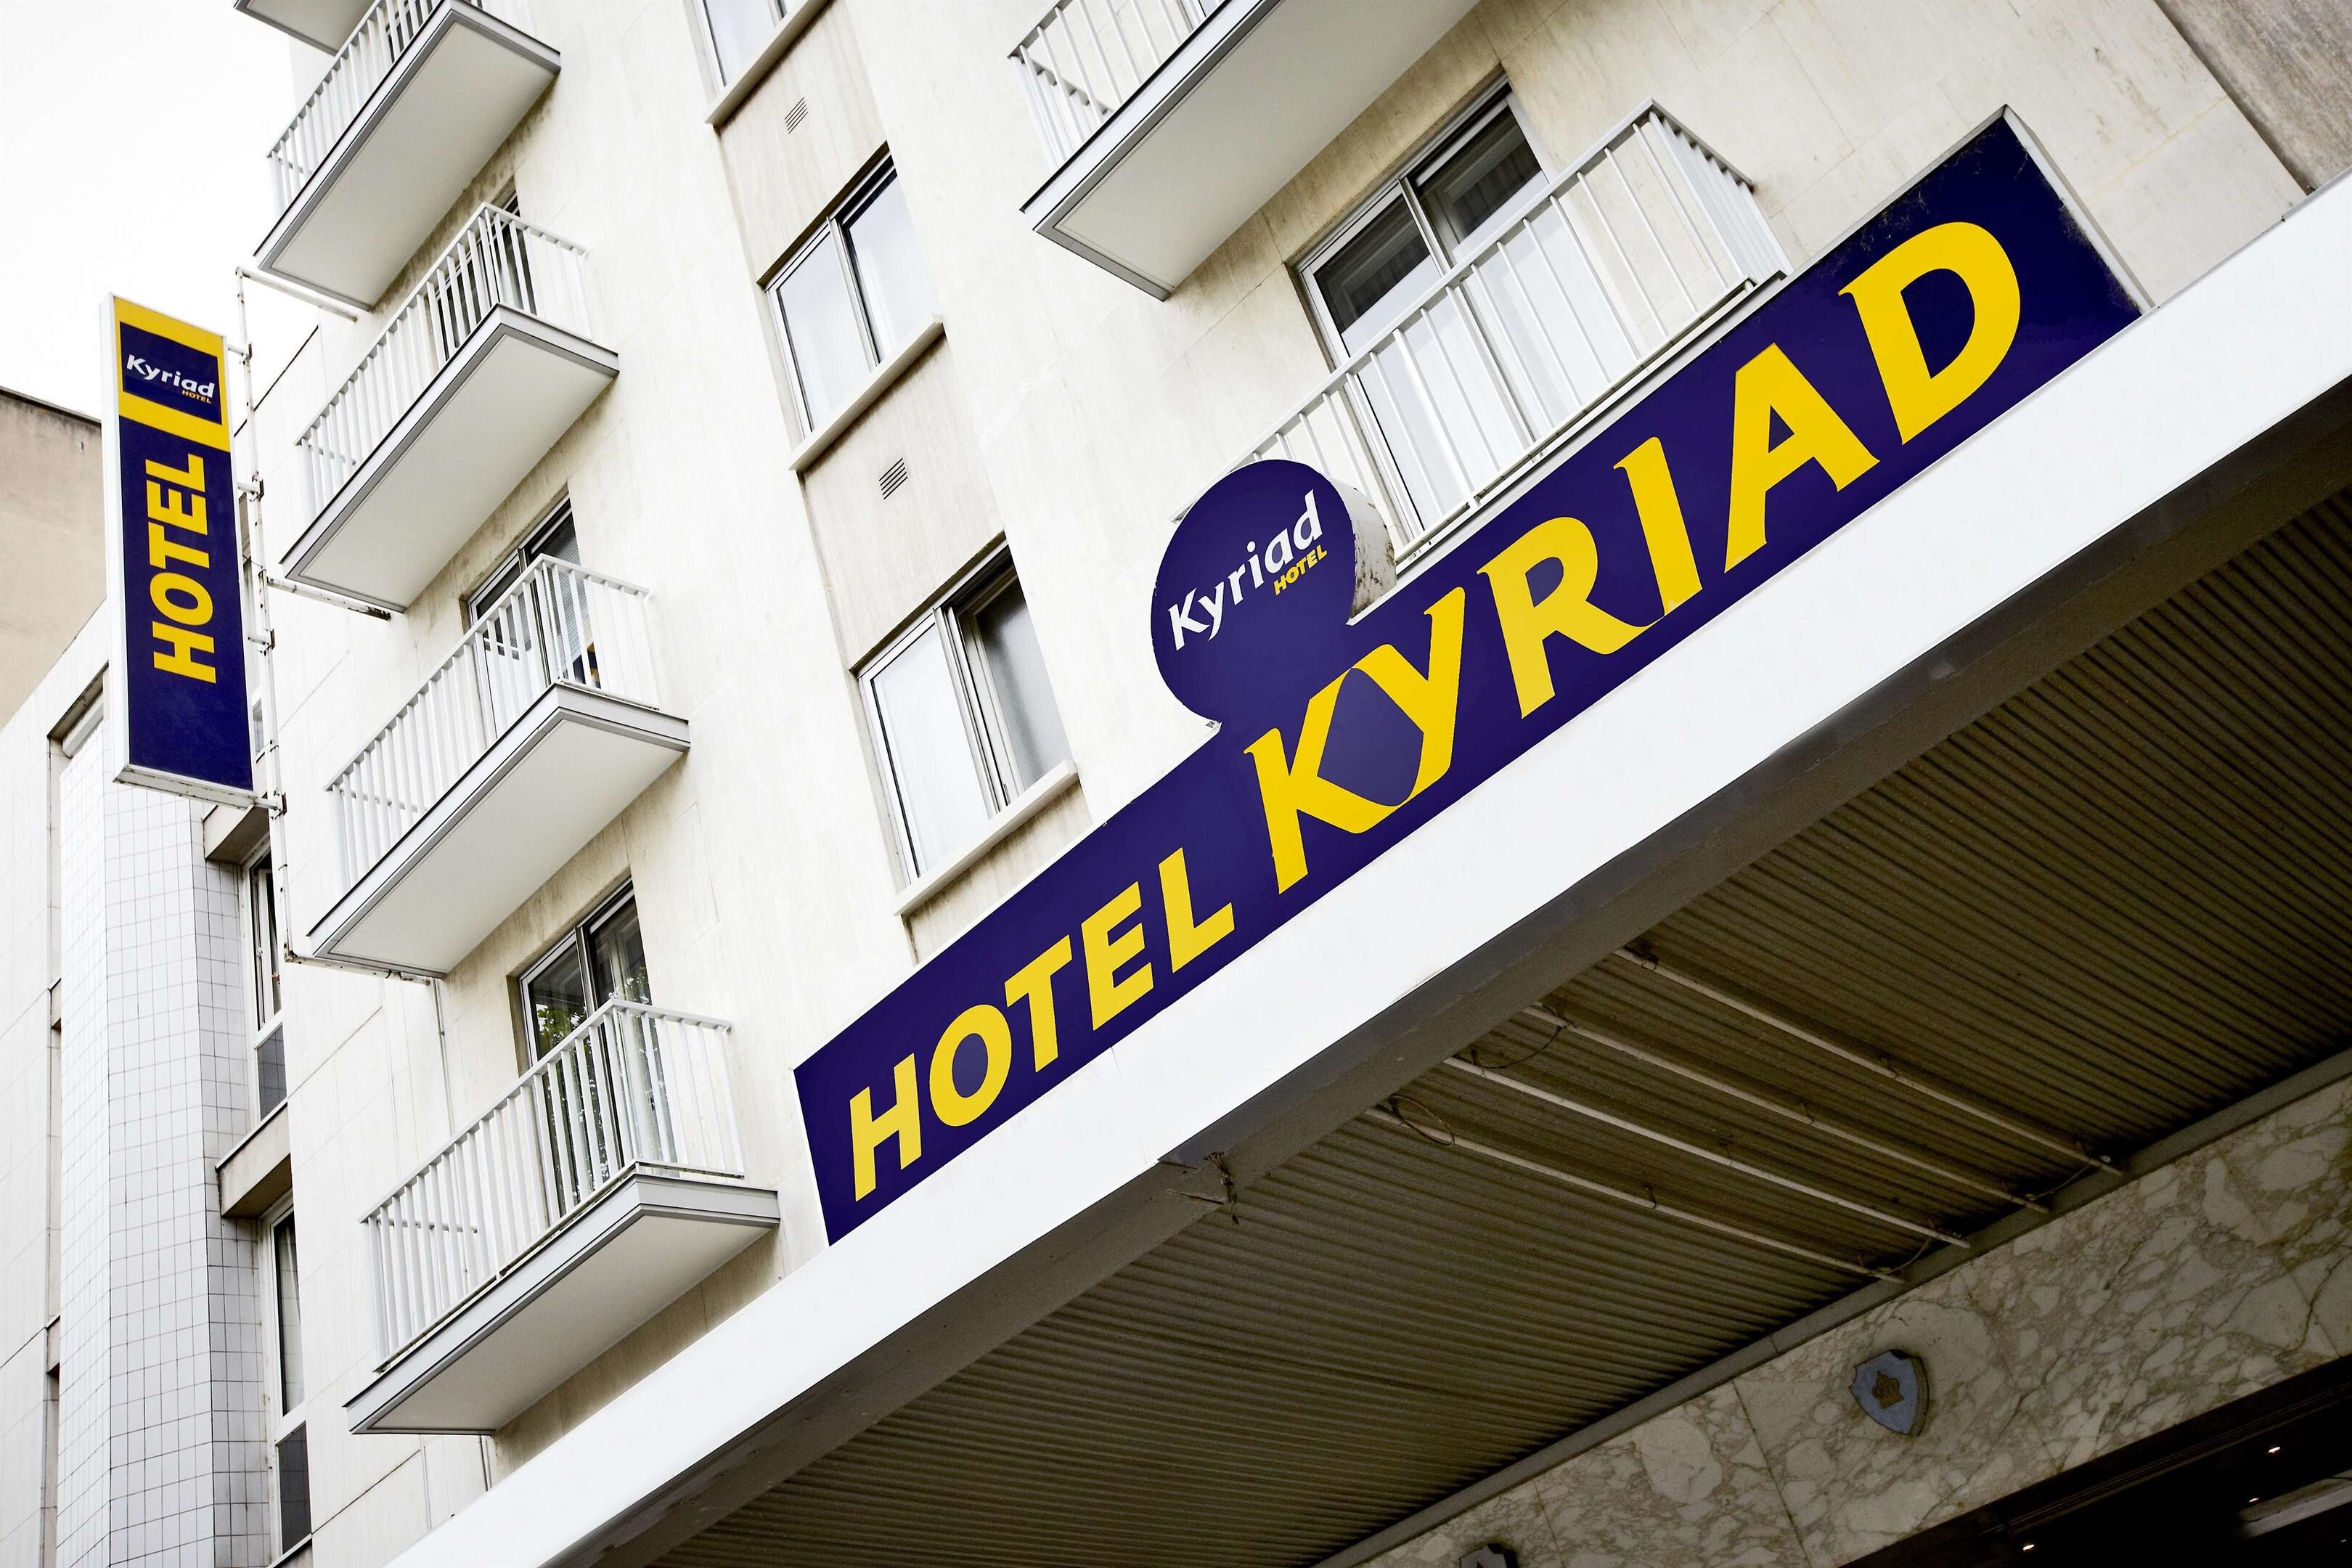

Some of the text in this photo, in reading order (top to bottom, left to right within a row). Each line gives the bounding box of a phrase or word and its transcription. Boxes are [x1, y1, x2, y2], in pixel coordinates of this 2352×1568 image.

[126, 354, 216, 399] Kyriad
[181, 389, 212, 404] HOTEL
[145, 454, 216, 683] HOTEL
[1167, 489, 1323, 651] Kyriad
[1273, 544, 1328, 596] HOTEL
[849, 221, 2022, 1201] HOTEL KYRIAD
